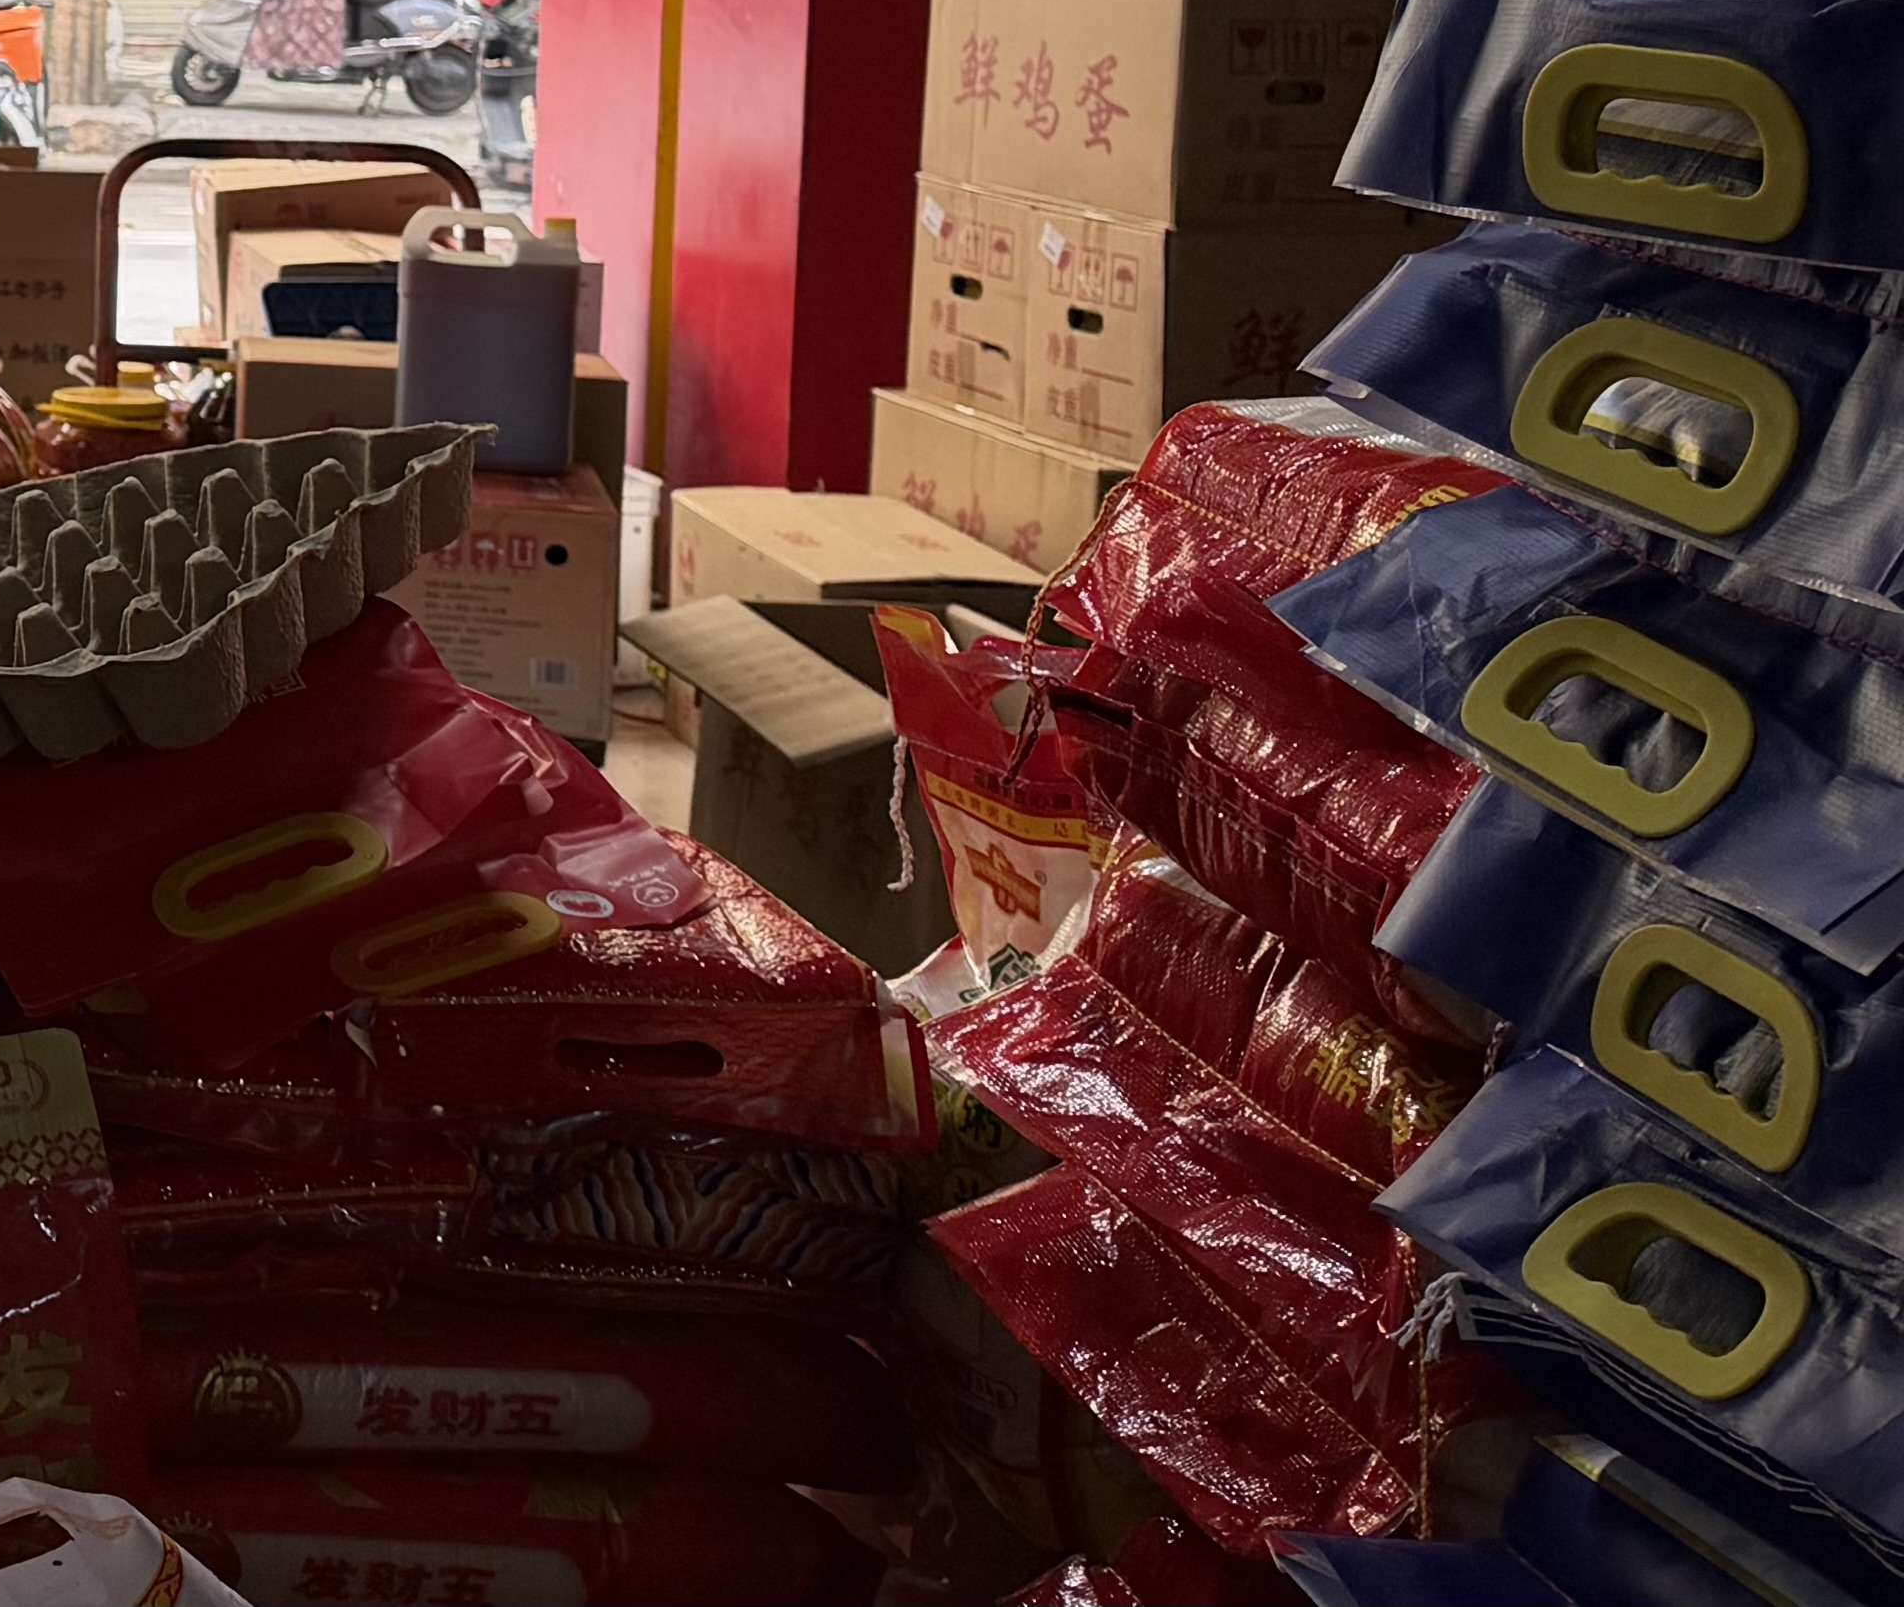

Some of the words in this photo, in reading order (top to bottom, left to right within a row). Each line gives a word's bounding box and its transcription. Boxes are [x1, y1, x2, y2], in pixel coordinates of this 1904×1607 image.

[954, 31, 1131, 156] 鲜鸡蛋
[354, 1387, 561, 1437] 发财五
